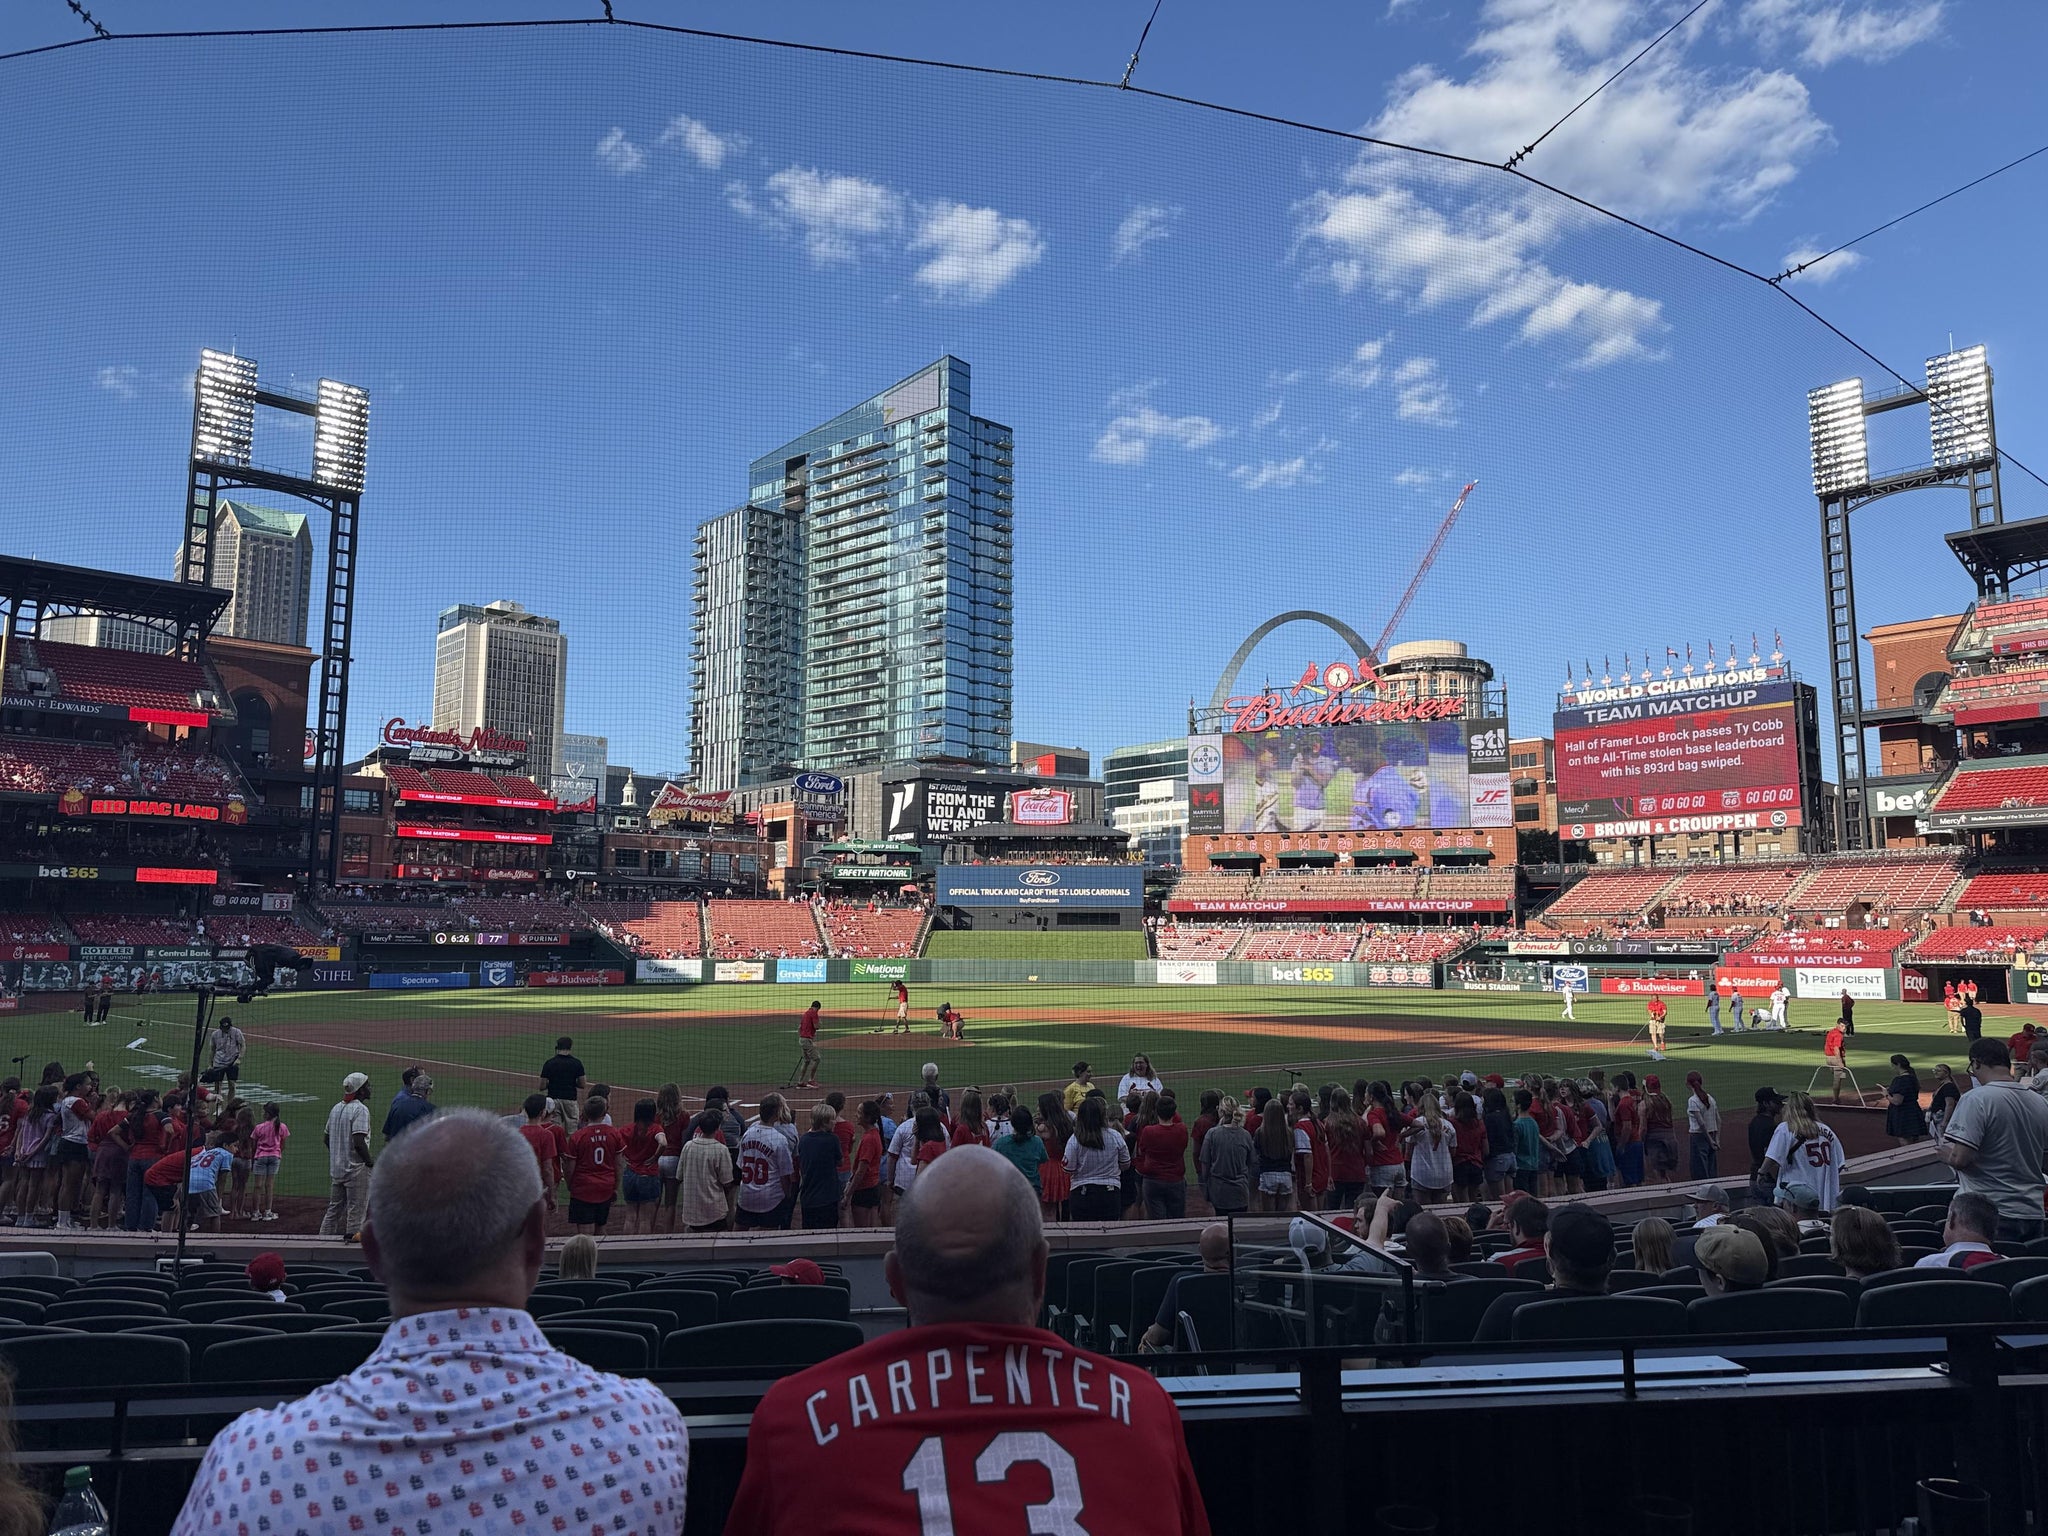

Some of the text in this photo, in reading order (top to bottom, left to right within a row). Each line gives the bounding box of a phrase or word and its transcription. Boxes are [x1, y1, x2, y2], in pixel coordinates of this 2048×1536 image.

[1577, 668, 1767, 705] WORLD CHAMPIONS
[50, 700, 100, 713] EDWARDS
[1223, 690, 1466, 733] Budweiser
[1583, 690, 1758, 723] TEAM MATCHUP
[384, 717, 527, 752] Cardinals Nation
[1566, 718, 1783, 752] Hall of Famer Lou Brock passes Ty Cobb
[1568, 734, 1784, 766] on the All-Time stolen base leaderboard
[469, 754, 514, 766] ROOFTOP
[1600, 754, 1744, 778] with his 893rd bag swiped.
[805, 776, 836, 791] Ford
[652, 789, 732, 808] Budweiser
[928, 792, 995, 808] FROM THE
[1662, 798, 1674, 810] GO
[1677, 796, 1690, 809] GO
[1692, 795, 1706, 808] GO
[1725, 788, 1794, 806] 66 GO GO GO
[129, 801, 219, 820] MAC LAND
[928, 805, 985, 820] LOU AND
[1022, 800, 1058, 812] Coca-Cola
[1564, 805, 1585, 814] Mercy
[650, 808, 734, 824] BREW HOUSE
[927, 818, 970, 832] WE'RE
[1594, 814, 1757, 836] BROWN & CROUPPEN
[1236, 841, 1244, 850] 2
[1250, 840, 1257, 850] 6
[1264, 840, 1272, 850] 9
[1280, 840, 1290, 850] 10
[1298, 839, 1310, 850] 14
[1318, 838, 1330, 850] 17
[1338, 838, 1353, 850] 20
[1362, 838, 1378, 849] 23
[1385, 838, 1402, 848] 24
[1409, 836, 1426, 848] 42
[1434, 836, 1450, 848] 45
[1456, 836, 1473, 847] 85
[38, 866, 98, 878] bet365
[838, 868, 867, 876] SAFETY
[868, 870, 908, 878] NATIONAL
[1026, 872, 1052, 884] Ford
[229, 896, 238, 904] GO
[274, 900, 288, 909] 83
[1752, 956, 1862, 964] TEAM MATCHUP
[313, 969, 354, 982] STIFEL
[866, 964, 906, 974] National
[1272, 966, 1334, 982] bet365
[1560, 968, 1580, 978] Ford
[402, 976, 435, 985] Spectrum
[1488, 983, 1520, 991] STADIUM
[1632, 982, 1687, 992] Budweiser
[1813, 976, 1881, 984] PERFICIENT
[594, 1147, 604, 1165] 0
[1806, 1141, 1832, 1168] 50
[742, 1156, 770, 1185] 50
[806, 1345, 1131, 1446] CARPENTER
[903, 1431, 1090, 1536] 13
